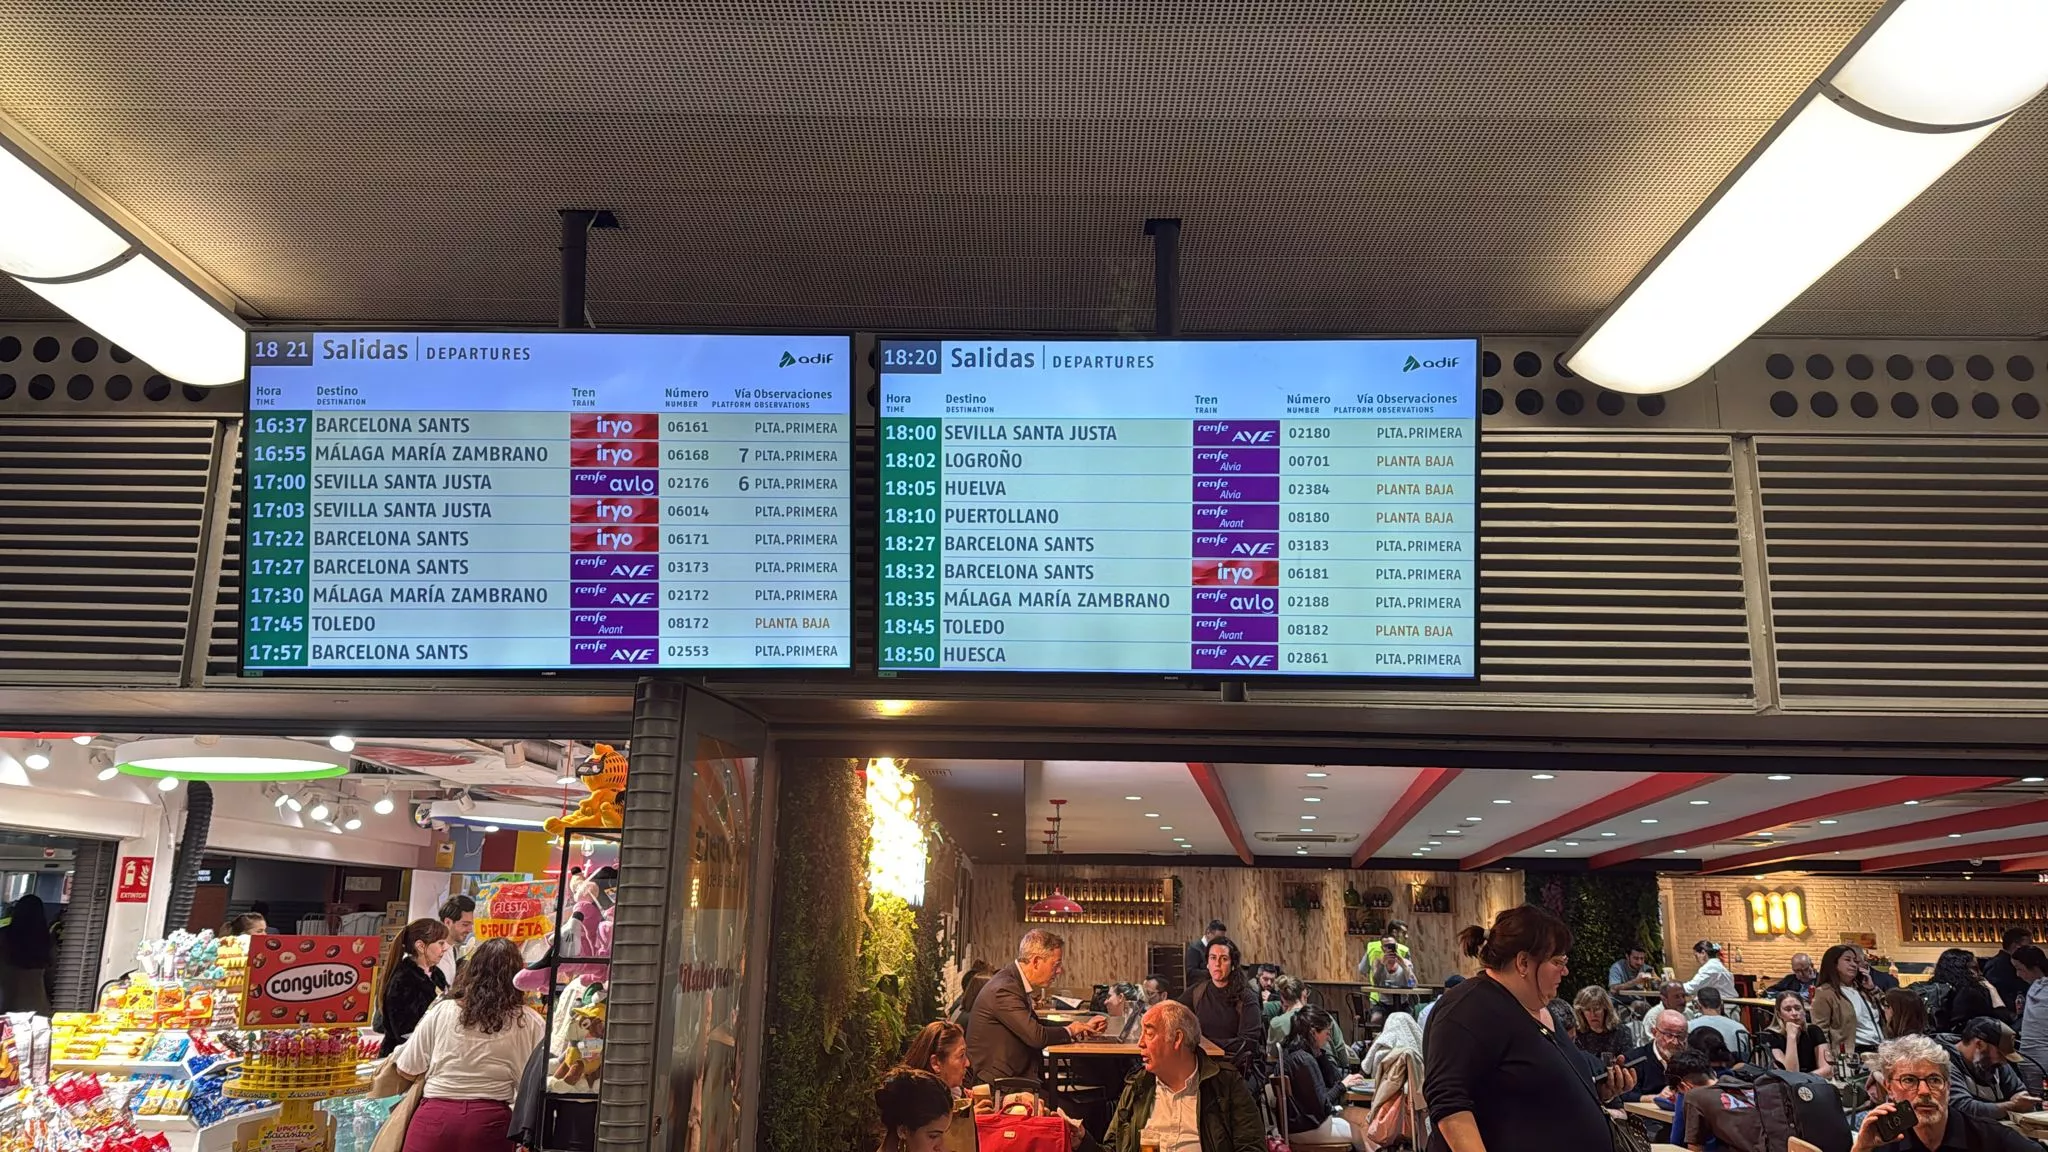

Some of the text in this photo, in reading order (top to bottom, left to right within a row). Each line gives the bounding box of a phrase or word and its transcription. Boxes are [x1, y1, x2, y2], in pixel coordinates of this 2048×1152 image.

[323, 338, 408, 359] Salidas
[427, 348, 529, 360] DEPARTURES
[885, 350, 937, 365] 18:20
[952, 347, 1034, 368] Salidas
[799, 354, 833, 363] adif
[1053, 356, 1153, 368] DEPARTURES
[1423, 357, 1460, 367] adif
[257, 386, 832, 399] Hora Destino Tren Número Vía Observaciones
[887, 393, 1457, 404] Hora Destino Tren Número Vía Observaciones
[256, 416, 837, 437] 16:37 BARCELONA SANTS iryo 06161 PLTA.PRIMERA
[886, 425, 1462, 444] 18:00 SEVILLA SANTA JUSTA AVE 02180 PLTA.PRIMERA
[255, 443, 837, 466] 16:55 MÁLAGA MARÍA ZAMBRANO iryo 06168 7 PLTA.PRIMERA
[886, 450, 1454, 471] 18:02 LOGROÑO Alvia 00701 PLANTA BAJA
[254, 471, 837, 495] 17:00 SEVILLA SANTA JUSTA renfe avlo 02176 6 PLTA.PRIMERA
[886, 481, 1453, 499] 18:05 HUELVA Alvia 02384 PLANTA BAJA
[254, 500, 709, 522] 17:03 SEVILLA SANTA JUSTA iryo 06014
[886, 508, 1453, 527] 18:10 PUERTOLLANO Avant 08180 PLANTA BAJA
[253, 529, 709, 550] 17:22 BARCELONA SANTS iryo 06171
[886, 536, 1328, 552] 18:27 BARCELONA SANTS 03183
[252, 559, 837, 578] 17:27 BARCELONA SANTS AVE 03173 PLTA.PRIMERA
[885, 563, 1461, 584] 18:32 BARCELONA SANTS iryo 06181 PLTA.PRIMERA
[252, 584, 708, 603] 17:30 MÁLAGA MARÍA ZAMBRANO 02172
[885, 589, 1329, 614] 18:35 MÁLAGA MARÍA ZAMBRANO renfe avlo 02188
[251, 616, 830, 635] 17:45 TOLEDO Avant 08172 PLANTA BAJA
[885, 619, 1453, 640] 18:45 TOLEDO Avant 08182 PLANTA BAJA
[250, 645, 837, 660] 17:57 BARCELONA SANTS 02553 PLTA.PRIMERA
[885, 647, 1461, 665] 18:50 HUESCA 02861 PLTA.PRIMERA
[494, 901, 529, 914] FIESTA
[271, 970, 354, 994] conguitos
